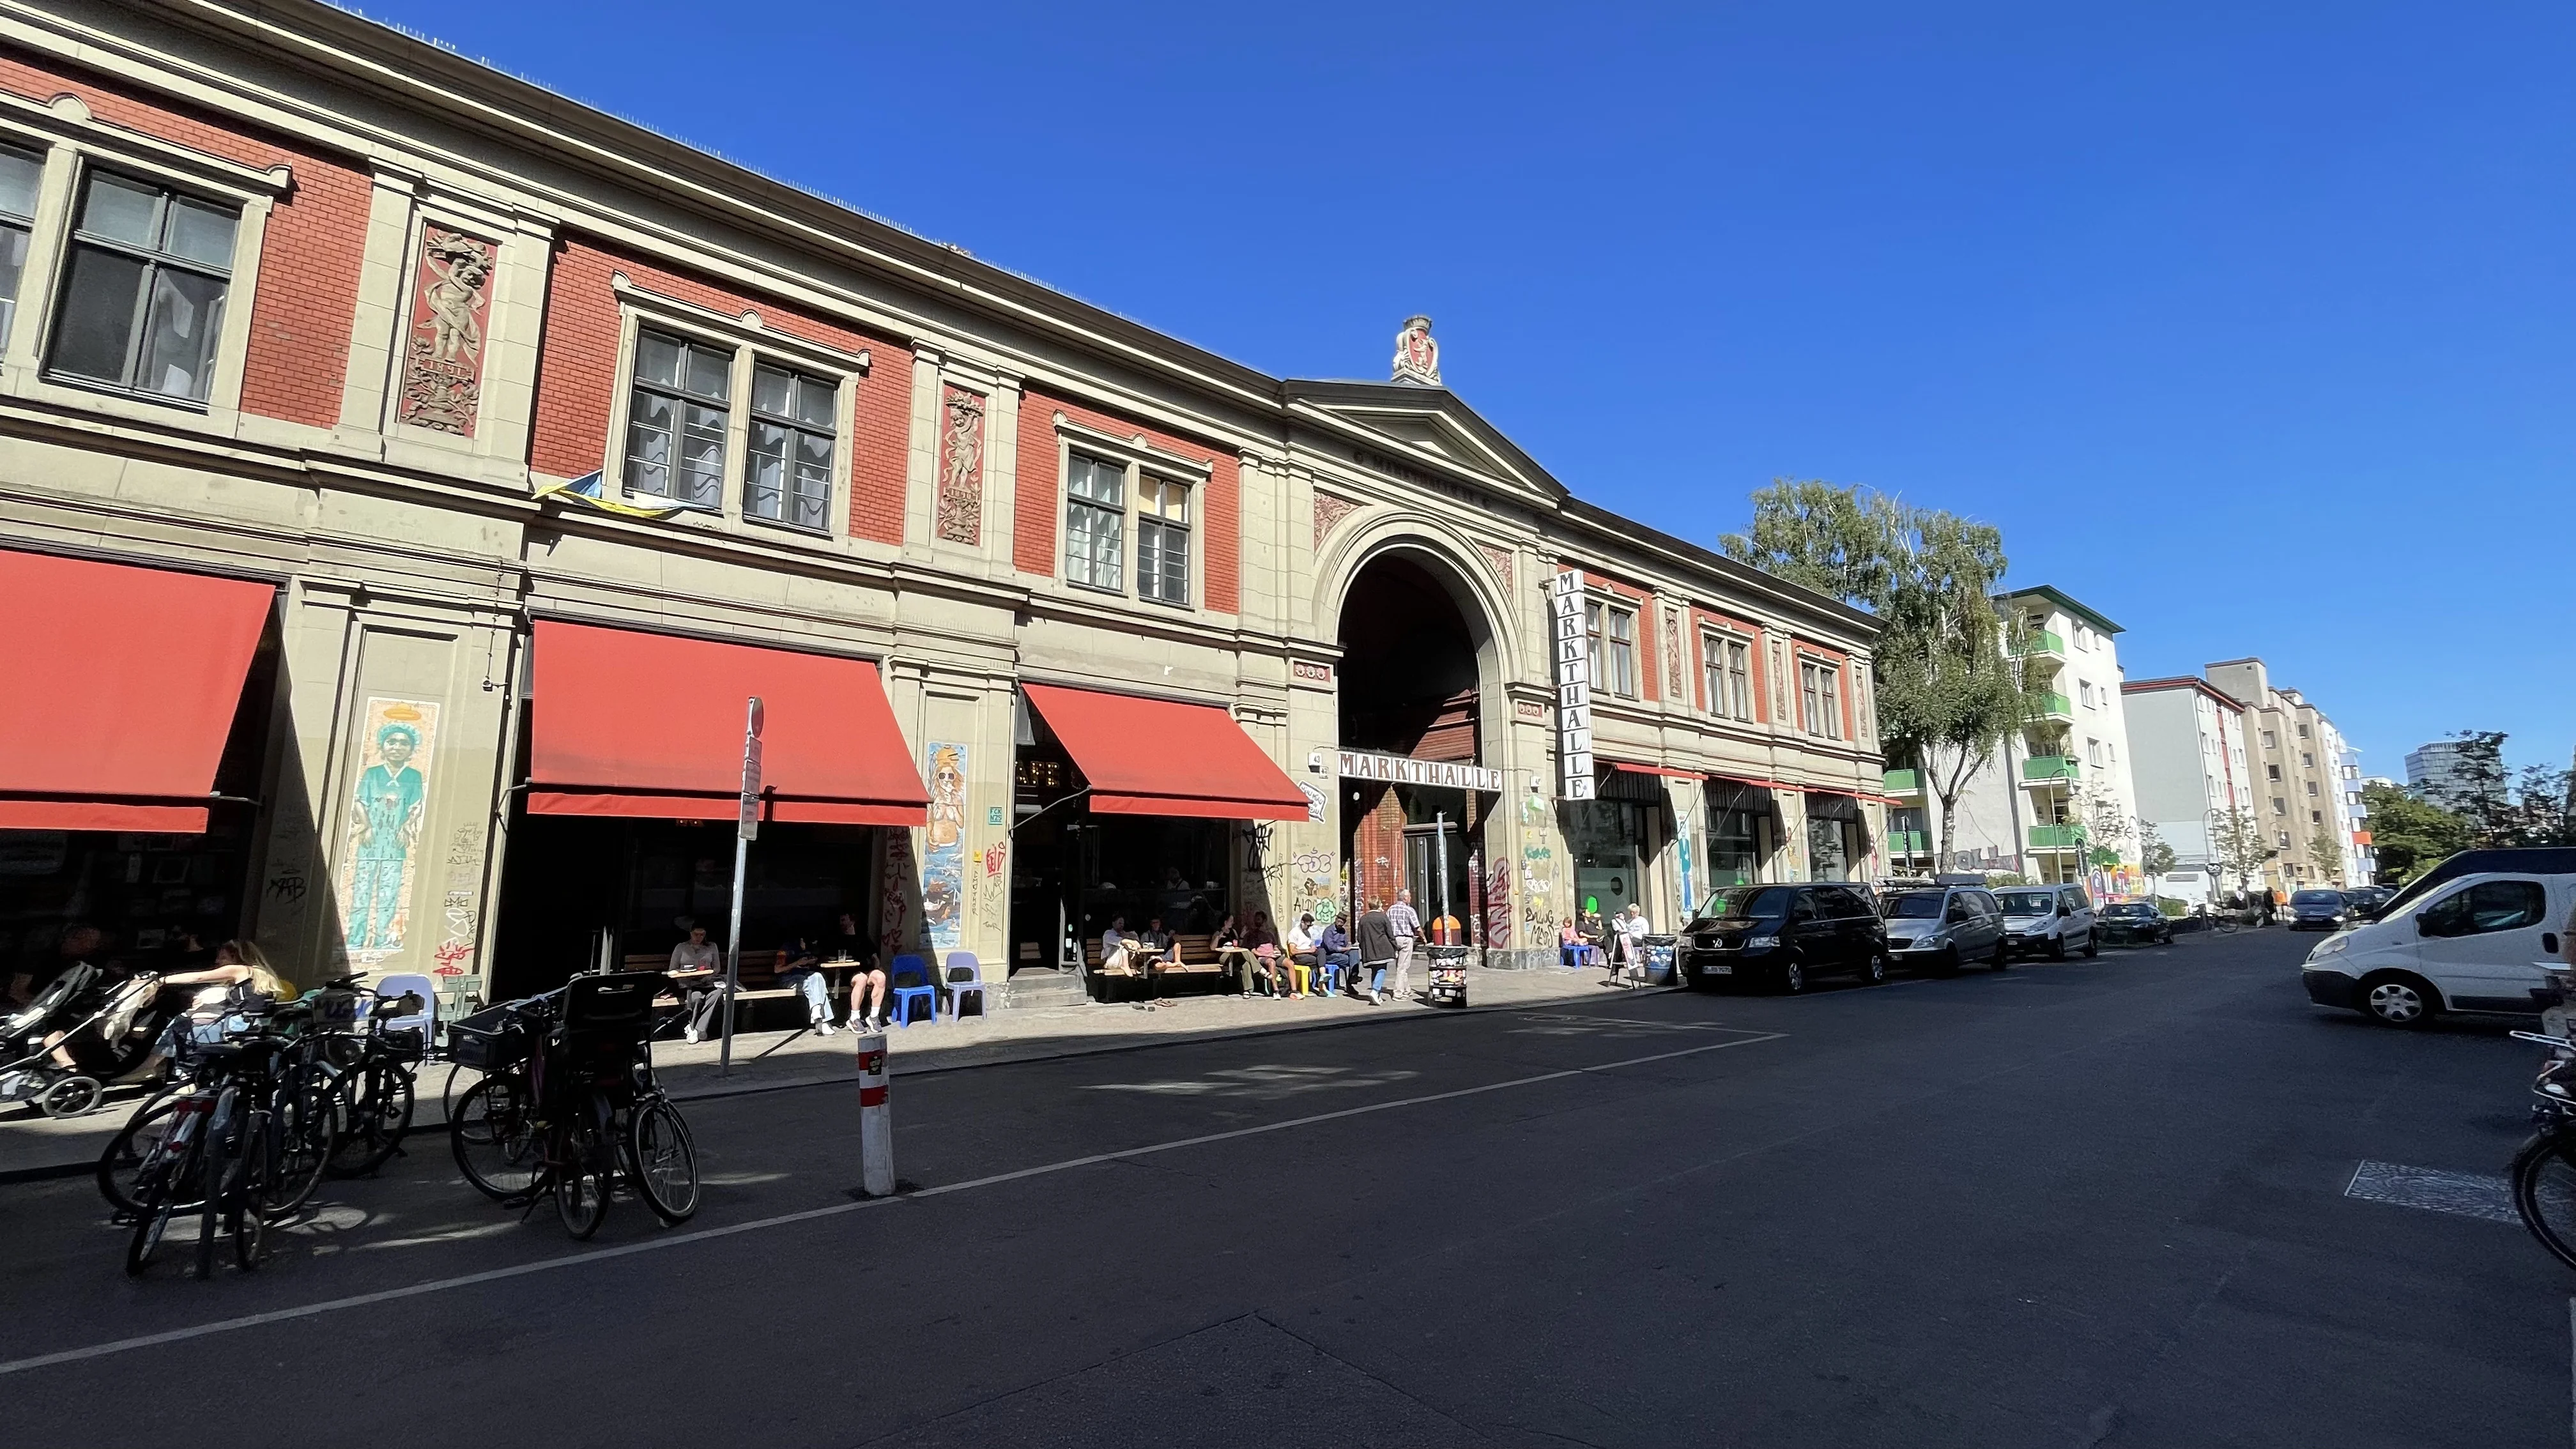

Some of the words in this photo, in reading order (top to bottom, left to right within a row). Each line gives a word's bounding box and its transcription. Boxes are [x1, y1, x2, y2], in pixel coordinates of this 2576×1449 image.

[1560, 572, 1584, 798] MARKTHALLE
[1015, 760, 1060, 786] AFE
[1314, 755, 1321, 763] 43
[1339, 752, 1500, 789] MARKTHALLE
